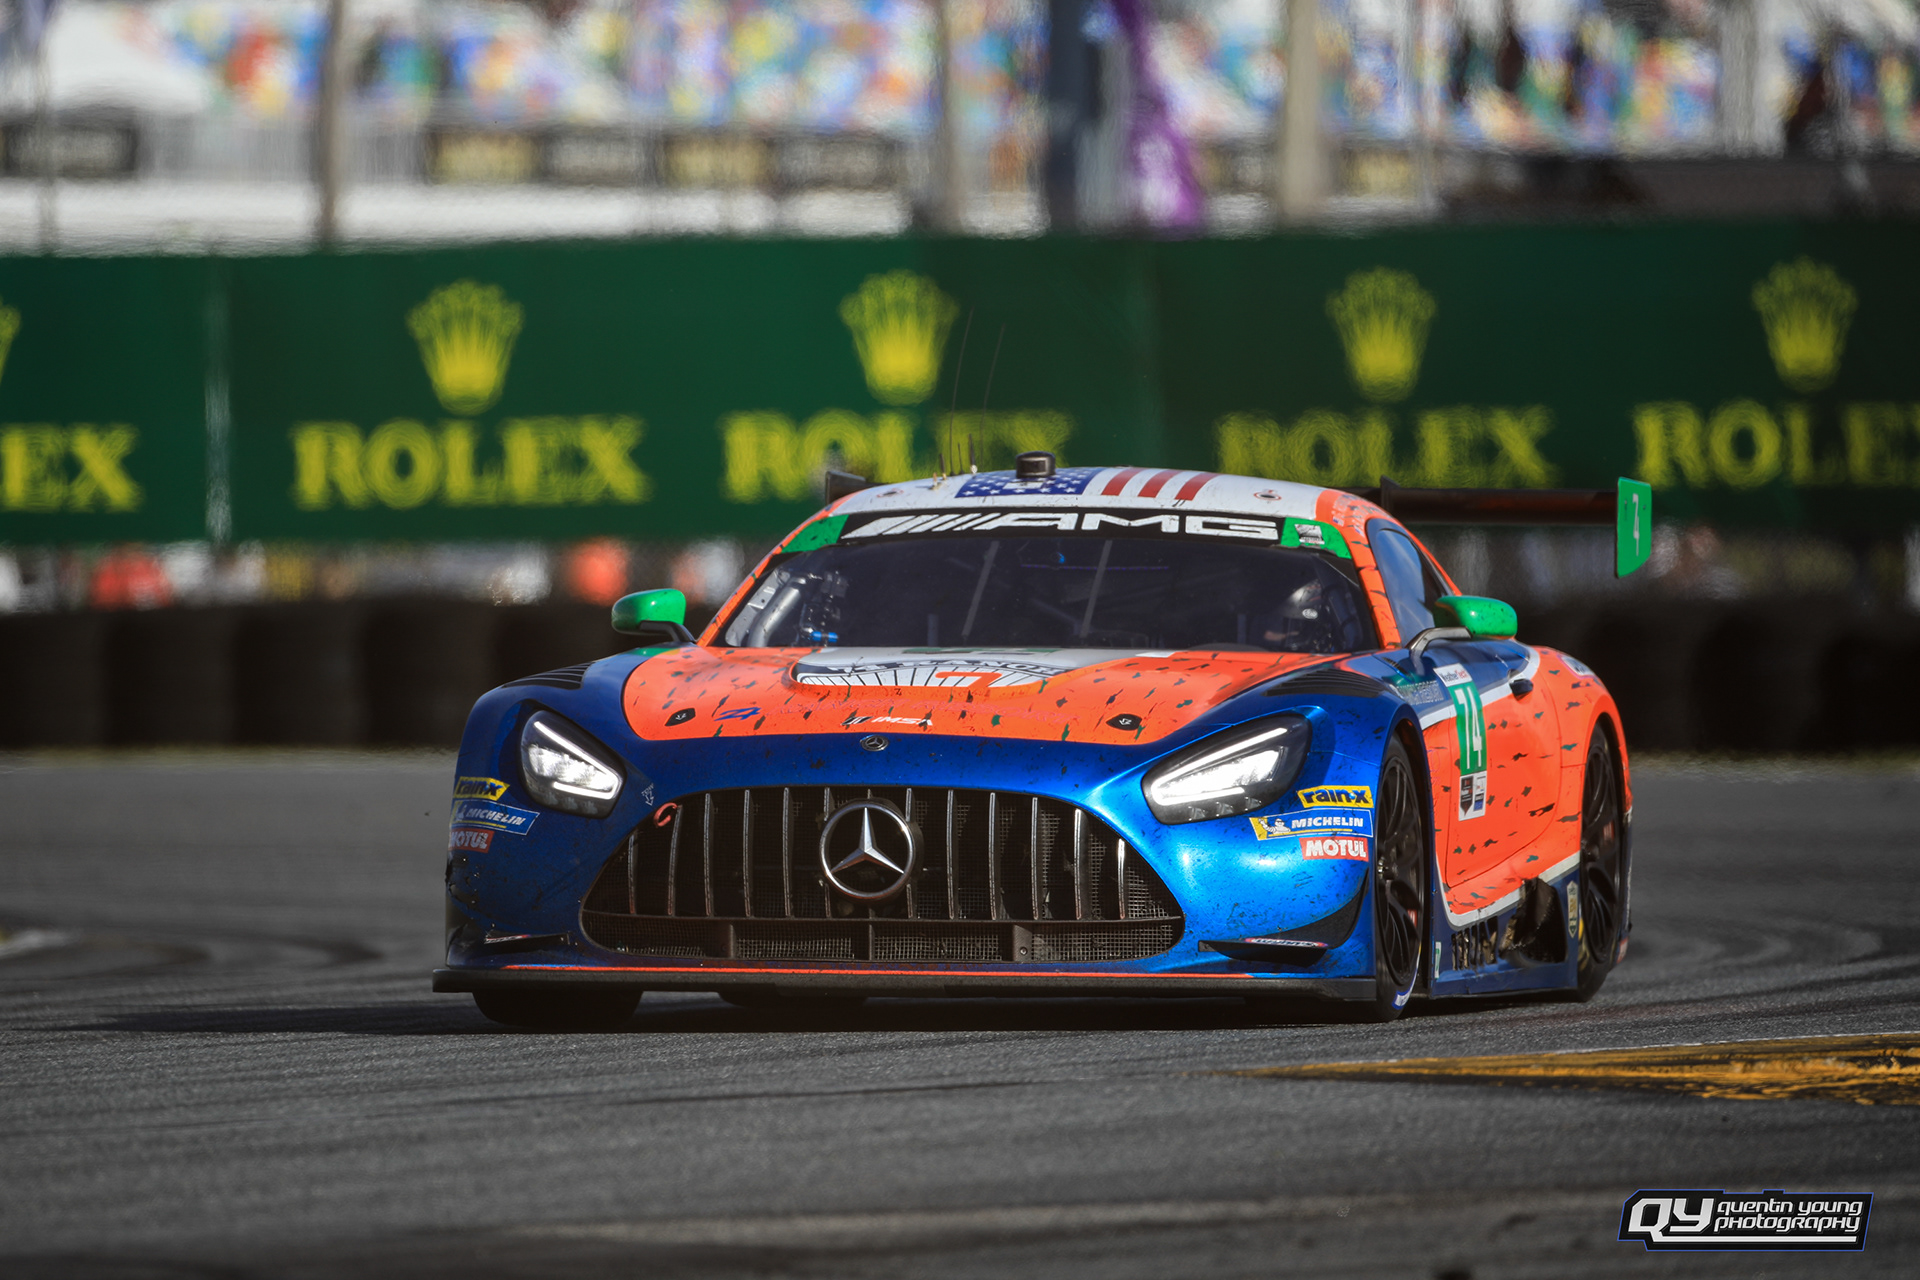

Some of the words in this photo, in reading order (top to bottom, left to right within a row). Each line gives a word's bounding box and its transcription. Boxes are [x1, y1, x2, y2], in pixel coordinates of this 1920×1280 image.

[293, 414, 650, 510] ROLEX
[1217, 405, 1558, 490] ROLEX
[1633, 399, 1920, 490] ROLE
[465, 808, 527, 826] MICHELIN
[1291, 817, 1364, 828] MICHELIN
[1304, 839, 1367, 858] MOTUL
